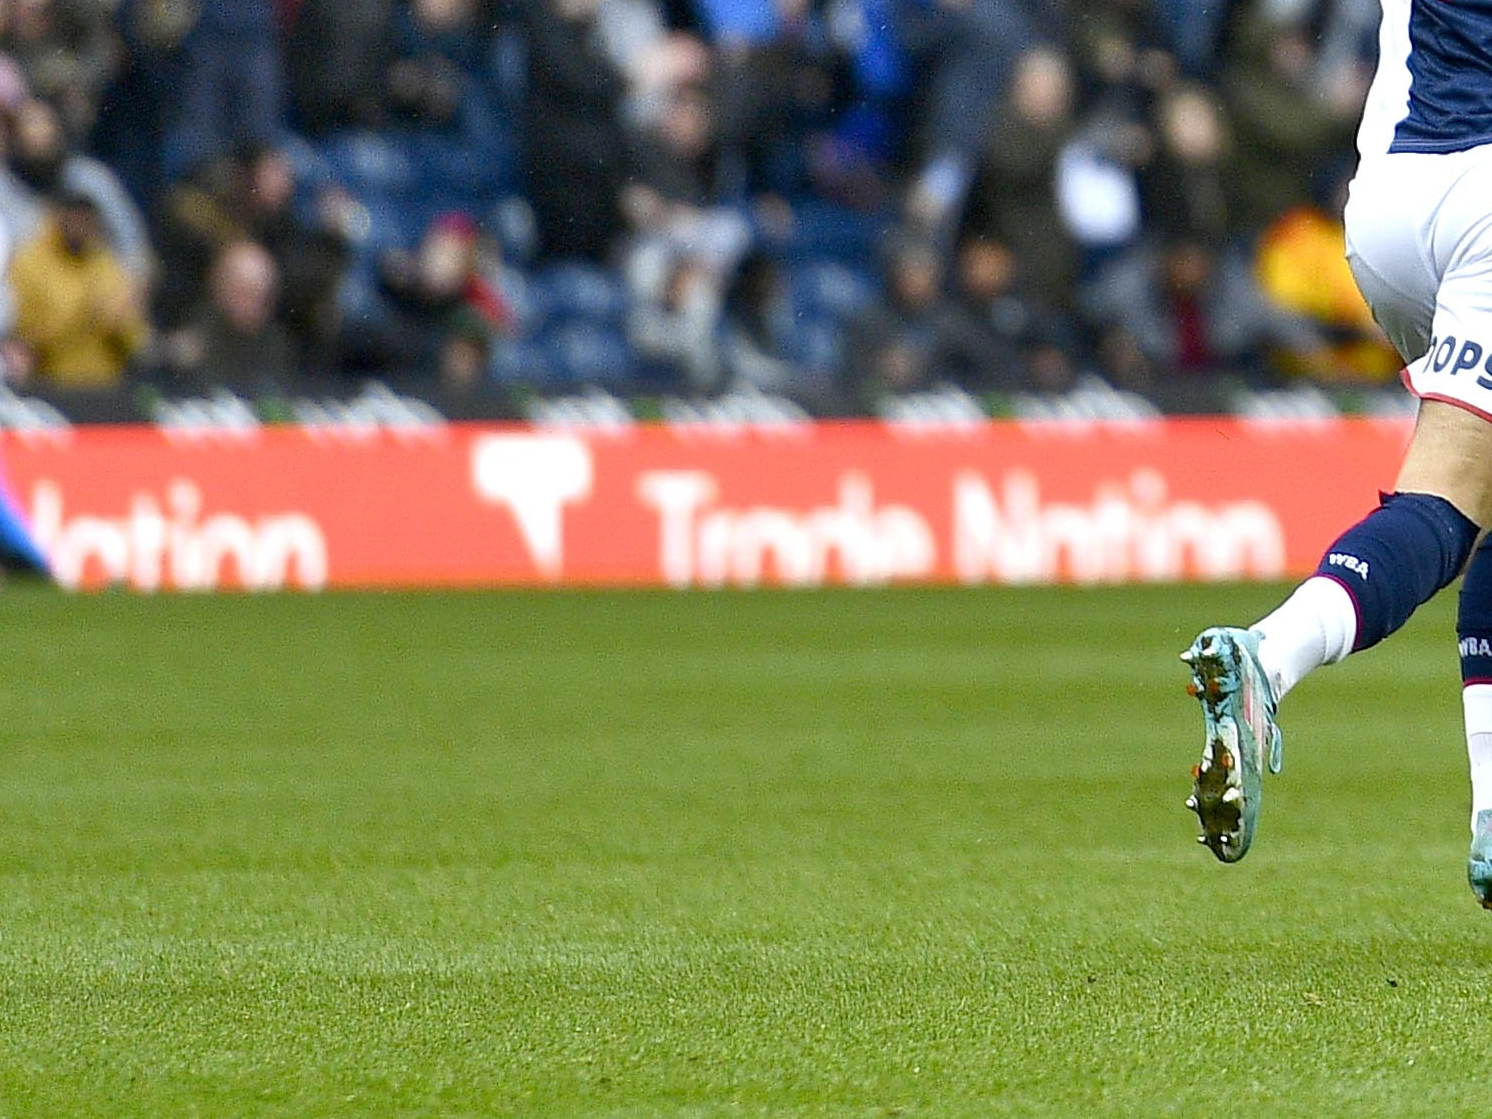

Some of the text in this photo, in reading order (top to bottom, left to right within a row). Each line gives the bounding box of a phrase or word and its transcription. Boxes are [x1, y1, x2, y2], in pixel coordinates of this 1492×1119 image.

[637, 465, 1287, 588] Trade Nation
[1328, 552, 1370, 581] WBA
